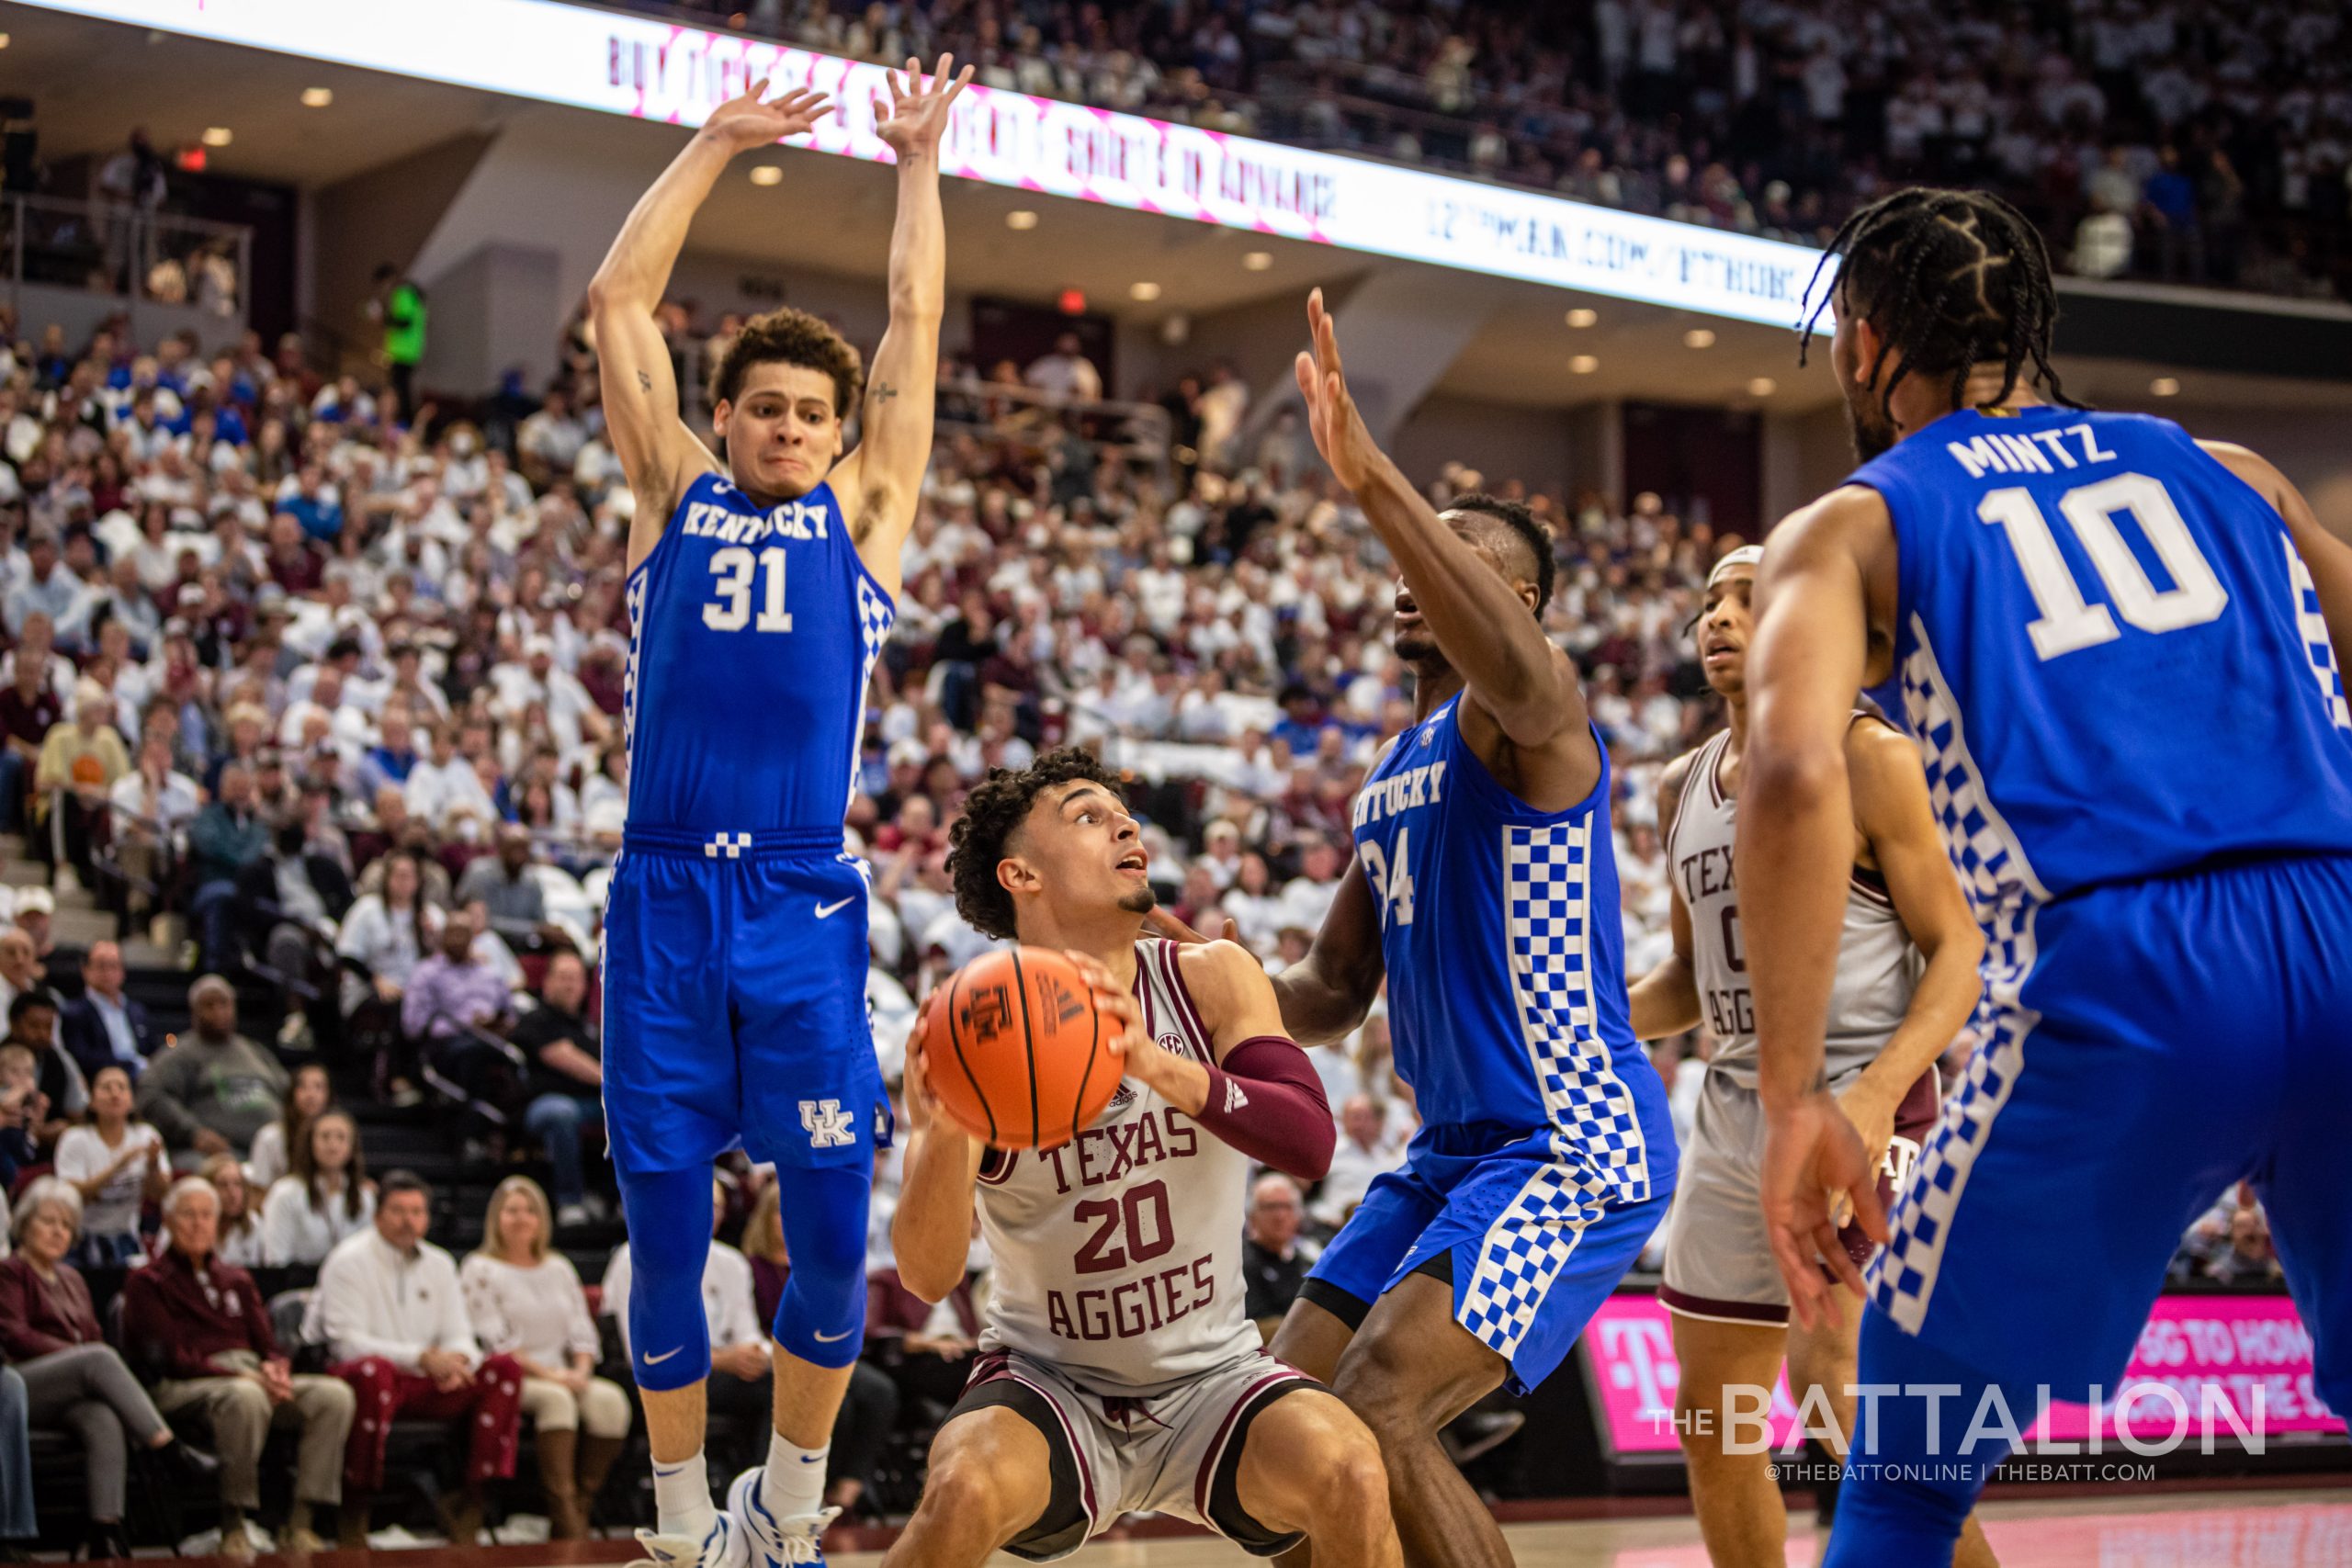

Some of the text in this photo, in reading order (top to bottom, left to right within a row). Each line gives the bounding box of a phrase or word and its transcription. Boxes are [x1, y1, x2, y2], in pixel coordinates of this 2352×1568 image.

[1947, 423, 2117, 478] MINTZ
[702, 547, 792, 632] 31
[1976, 471, 2229, 661] 10
[1360, 827, 1414, 933] 34
[1681, 844, 1736, 905] TEX
[1709, 989, 1756, 1036] AGG
[798, 1099, 856, 1147] UK
[1109, 1090, 1138, 1108] adidas
[1038, 1106, 1198, 1195] TEXAS
[1073, 1179, 1176, 1275] 20
[1047, 1253, 1215, 1341] AGGIES
[2181, 1319, 2236, 1367] TO
[2230, 1319, 2314, 1367] HOM
